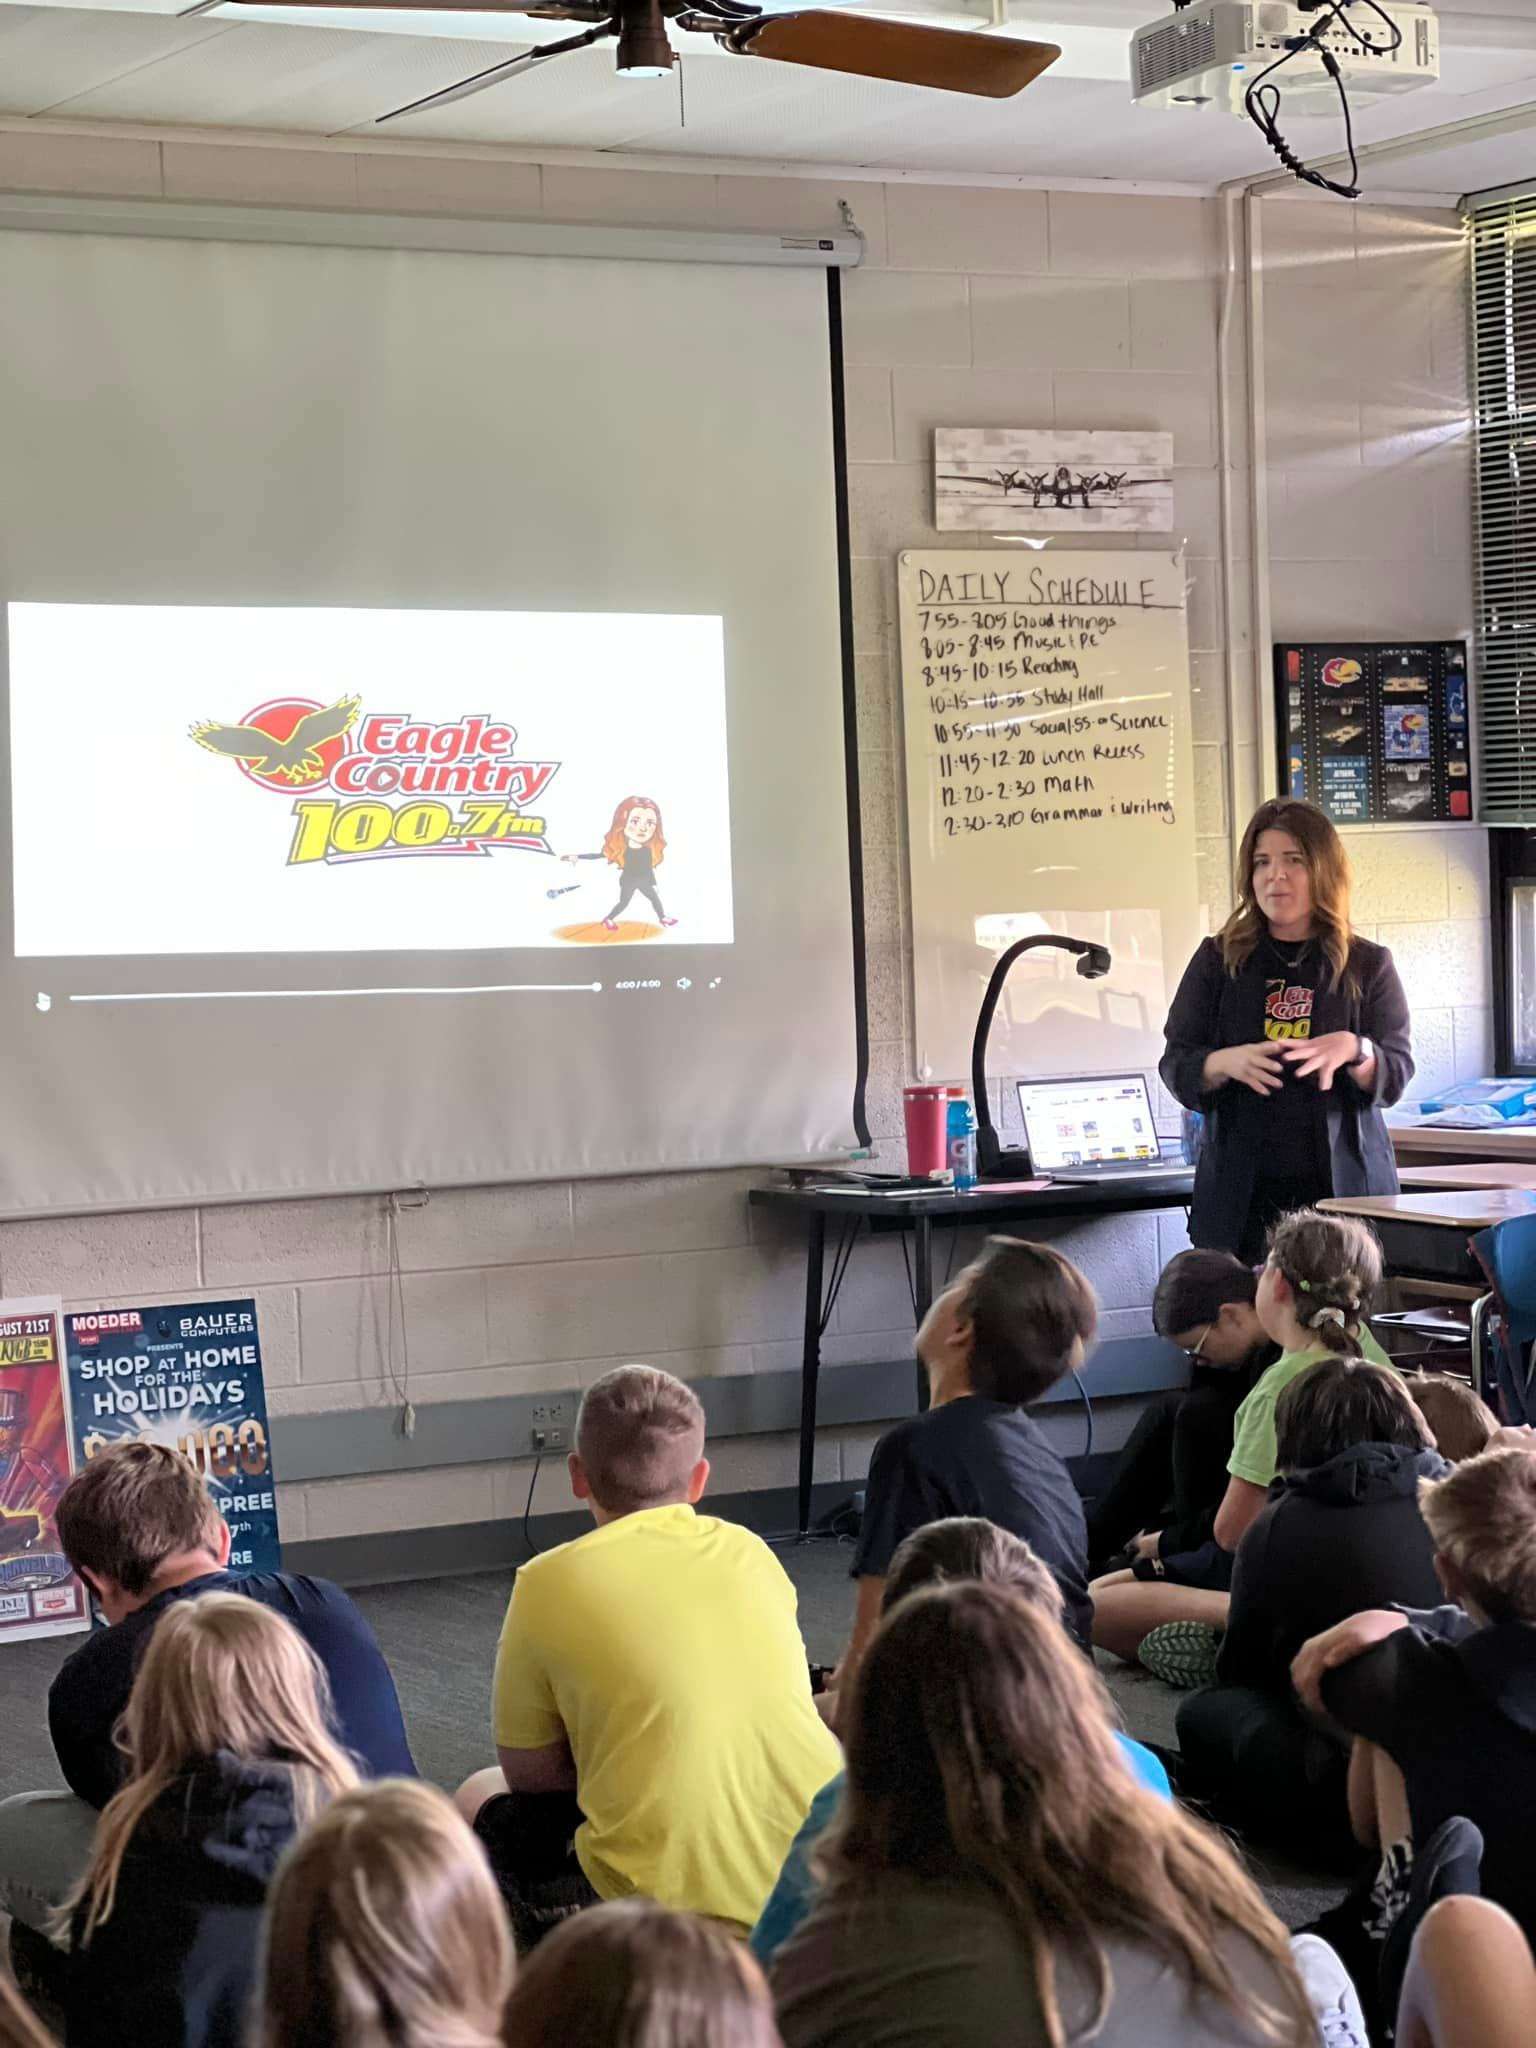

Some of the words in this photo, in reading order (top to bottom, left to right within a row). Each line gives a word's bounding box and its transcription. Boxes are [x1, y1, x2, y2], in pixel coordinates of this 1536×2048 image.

[919, 568, 1010, 603] DAILY
[1029, 567, 1155, 607] SCHEDULE
[1058, 612, 1117, 635] things
[1013, 631, 1066, 651] Music
[1022, 656, 1080, 679] Reading
[1031, 687, 1074, 709] Study
[1078, 684, 1104, 702] Hall
[361, 716, 516, 765] Eagle
[331, 757, 557, 806] Country
[1044, 775, 1096, 793] Math
[1030, 807, 1104, 825] Grammar
[25, 1319, 50, 1334] 21ST
[72, 1312, 142, 1331] MOEDER
[179, 1313, 253, 1331] BAUER
[180, 1325, 254, 1337] COMPUTERS
[146, 1342, 184, 1353] PRESENTS
[80, 1354, 150, 1380] SHOP
[158, 1358, 177, 1372] AT
[184, 1346, 257, 1369] HOME
[135, 1373, 166, 1388] FOR
[171, 1370, 202, 1385] THE
[93, 1379, 246, 1417] HOLIDAYS
[213, 1492, 274, 1514] PREE
